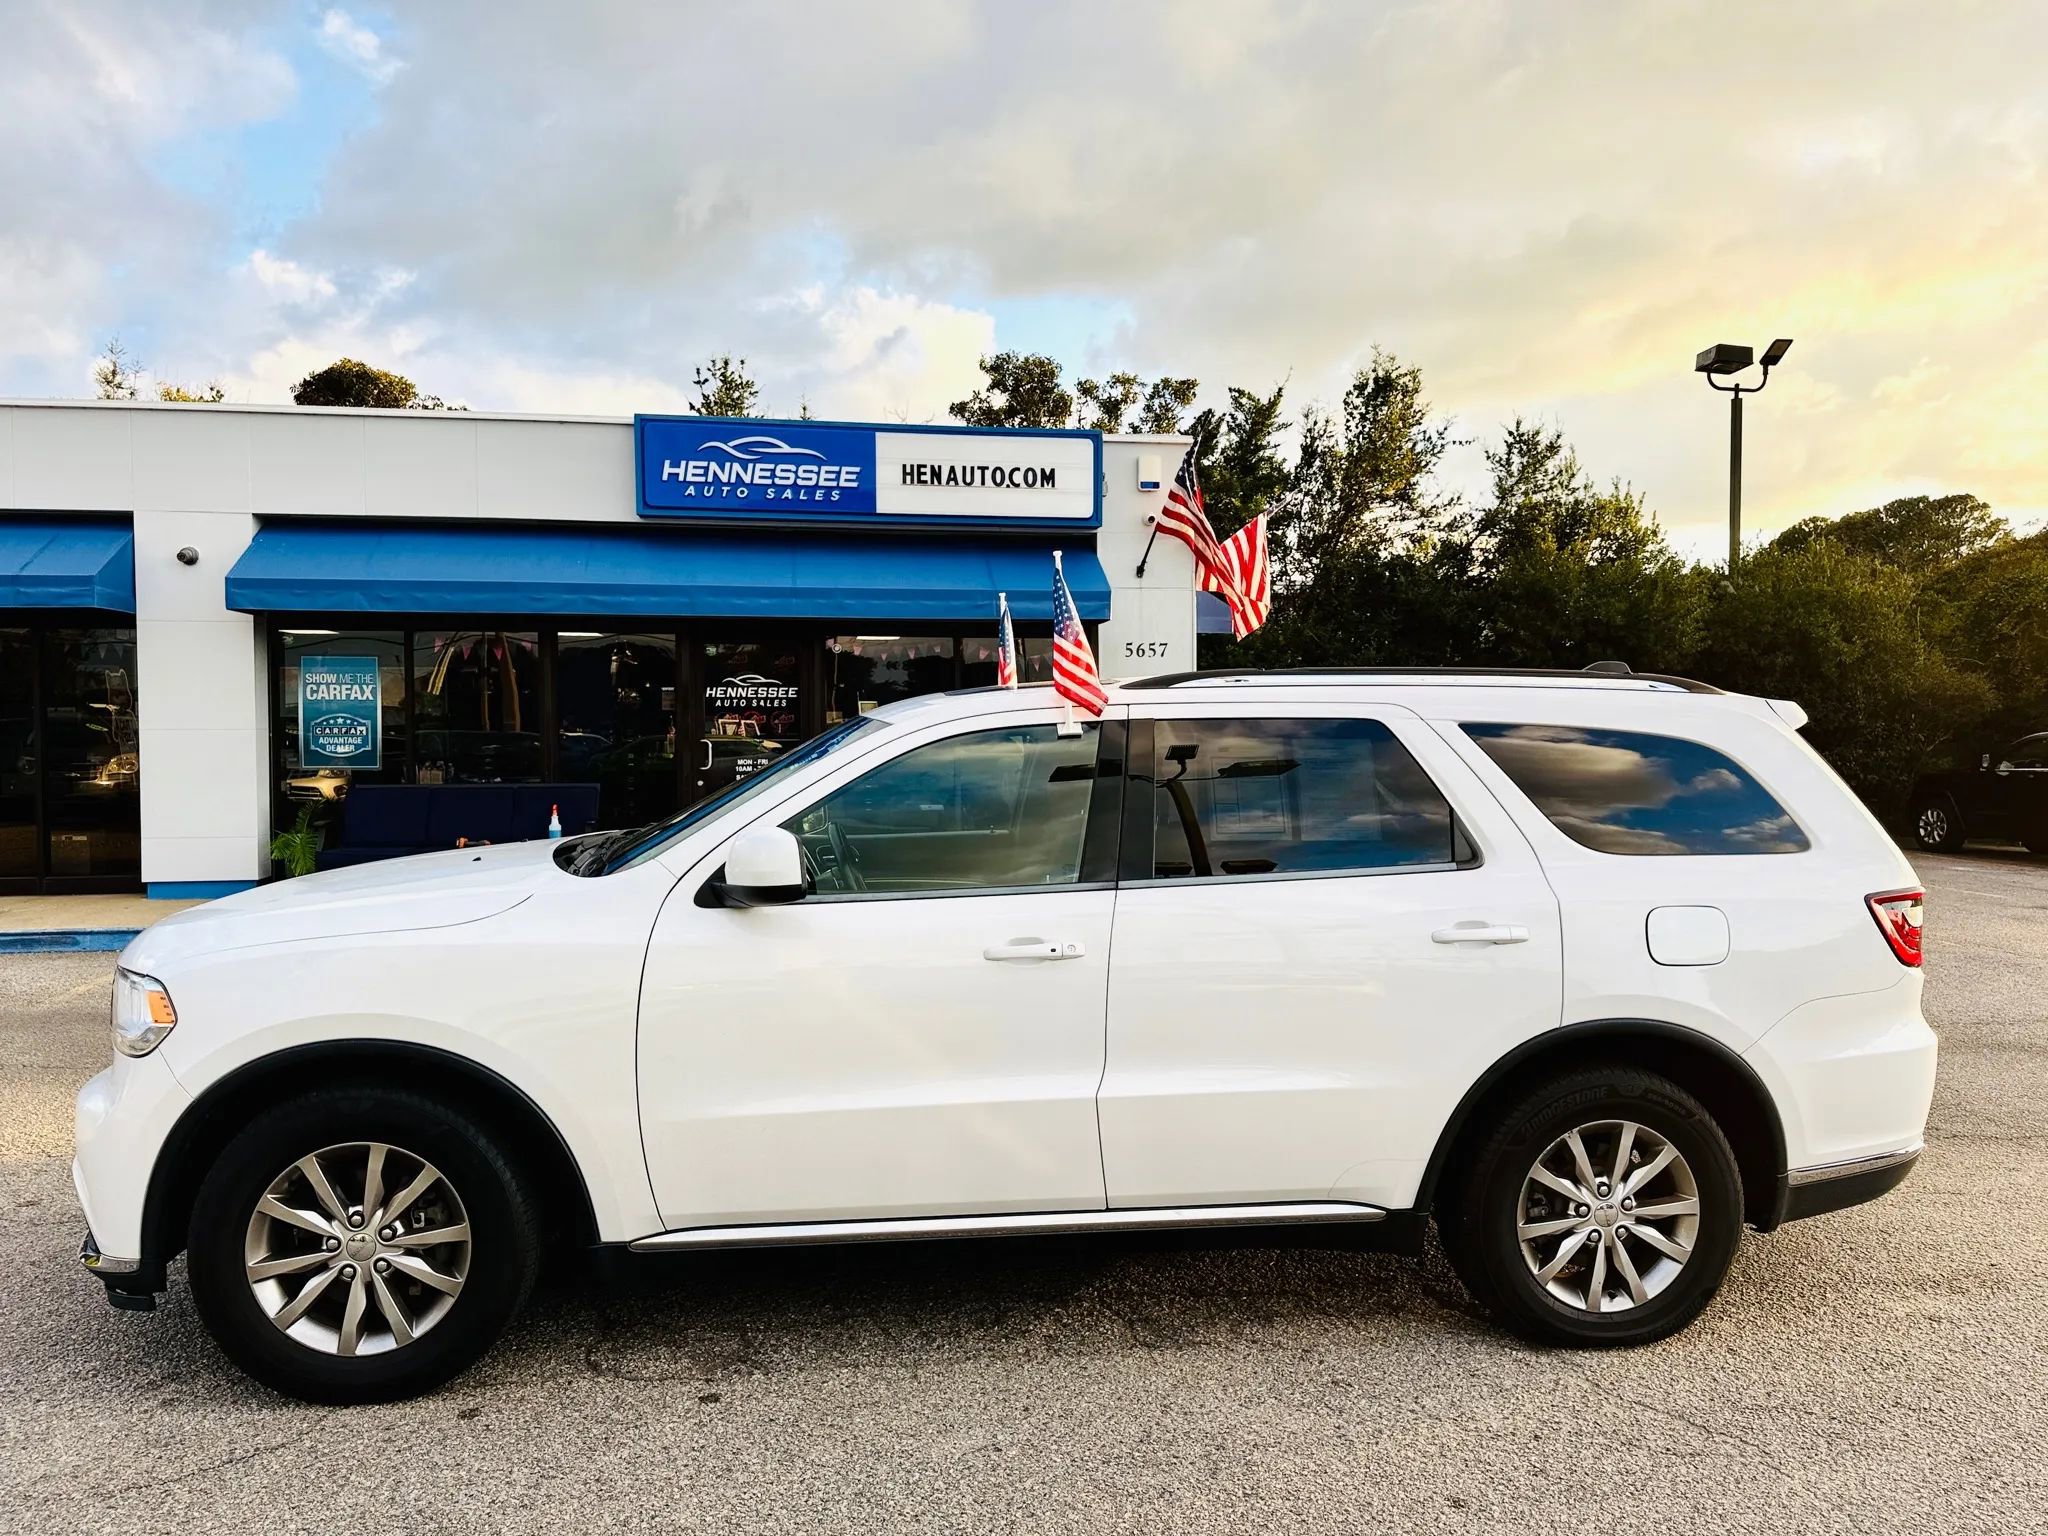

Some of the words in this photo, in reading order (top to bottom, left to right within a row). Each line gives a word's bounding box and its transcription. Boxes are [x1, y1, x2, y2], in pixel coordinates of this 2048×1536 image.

[661, 459, 861, 488] HENNESSEE
[901, 463, 1056, 489] HENAUTO.COM
[685, 485, 748, 499] AUTO
[766, 487, 841, 502] SALES
[1125, 642, 1168, 658] 5657
[305, 673, 337, 684] SHOW
[339, 673, 354, 684] ME
[356, 673, 374, 684] THE
[305, 685, 374, 701] CARFAX
[705, 687, 799, 698] HENNESSEE
[715, 699, 747, 707] AUTO
[751, 699, 787, 707] SALES
[314, 726, 367, 735] CARFAX
[318, 736, 363, 744] ADVANTAGE
[326, 745, 355, 753] DEALER
